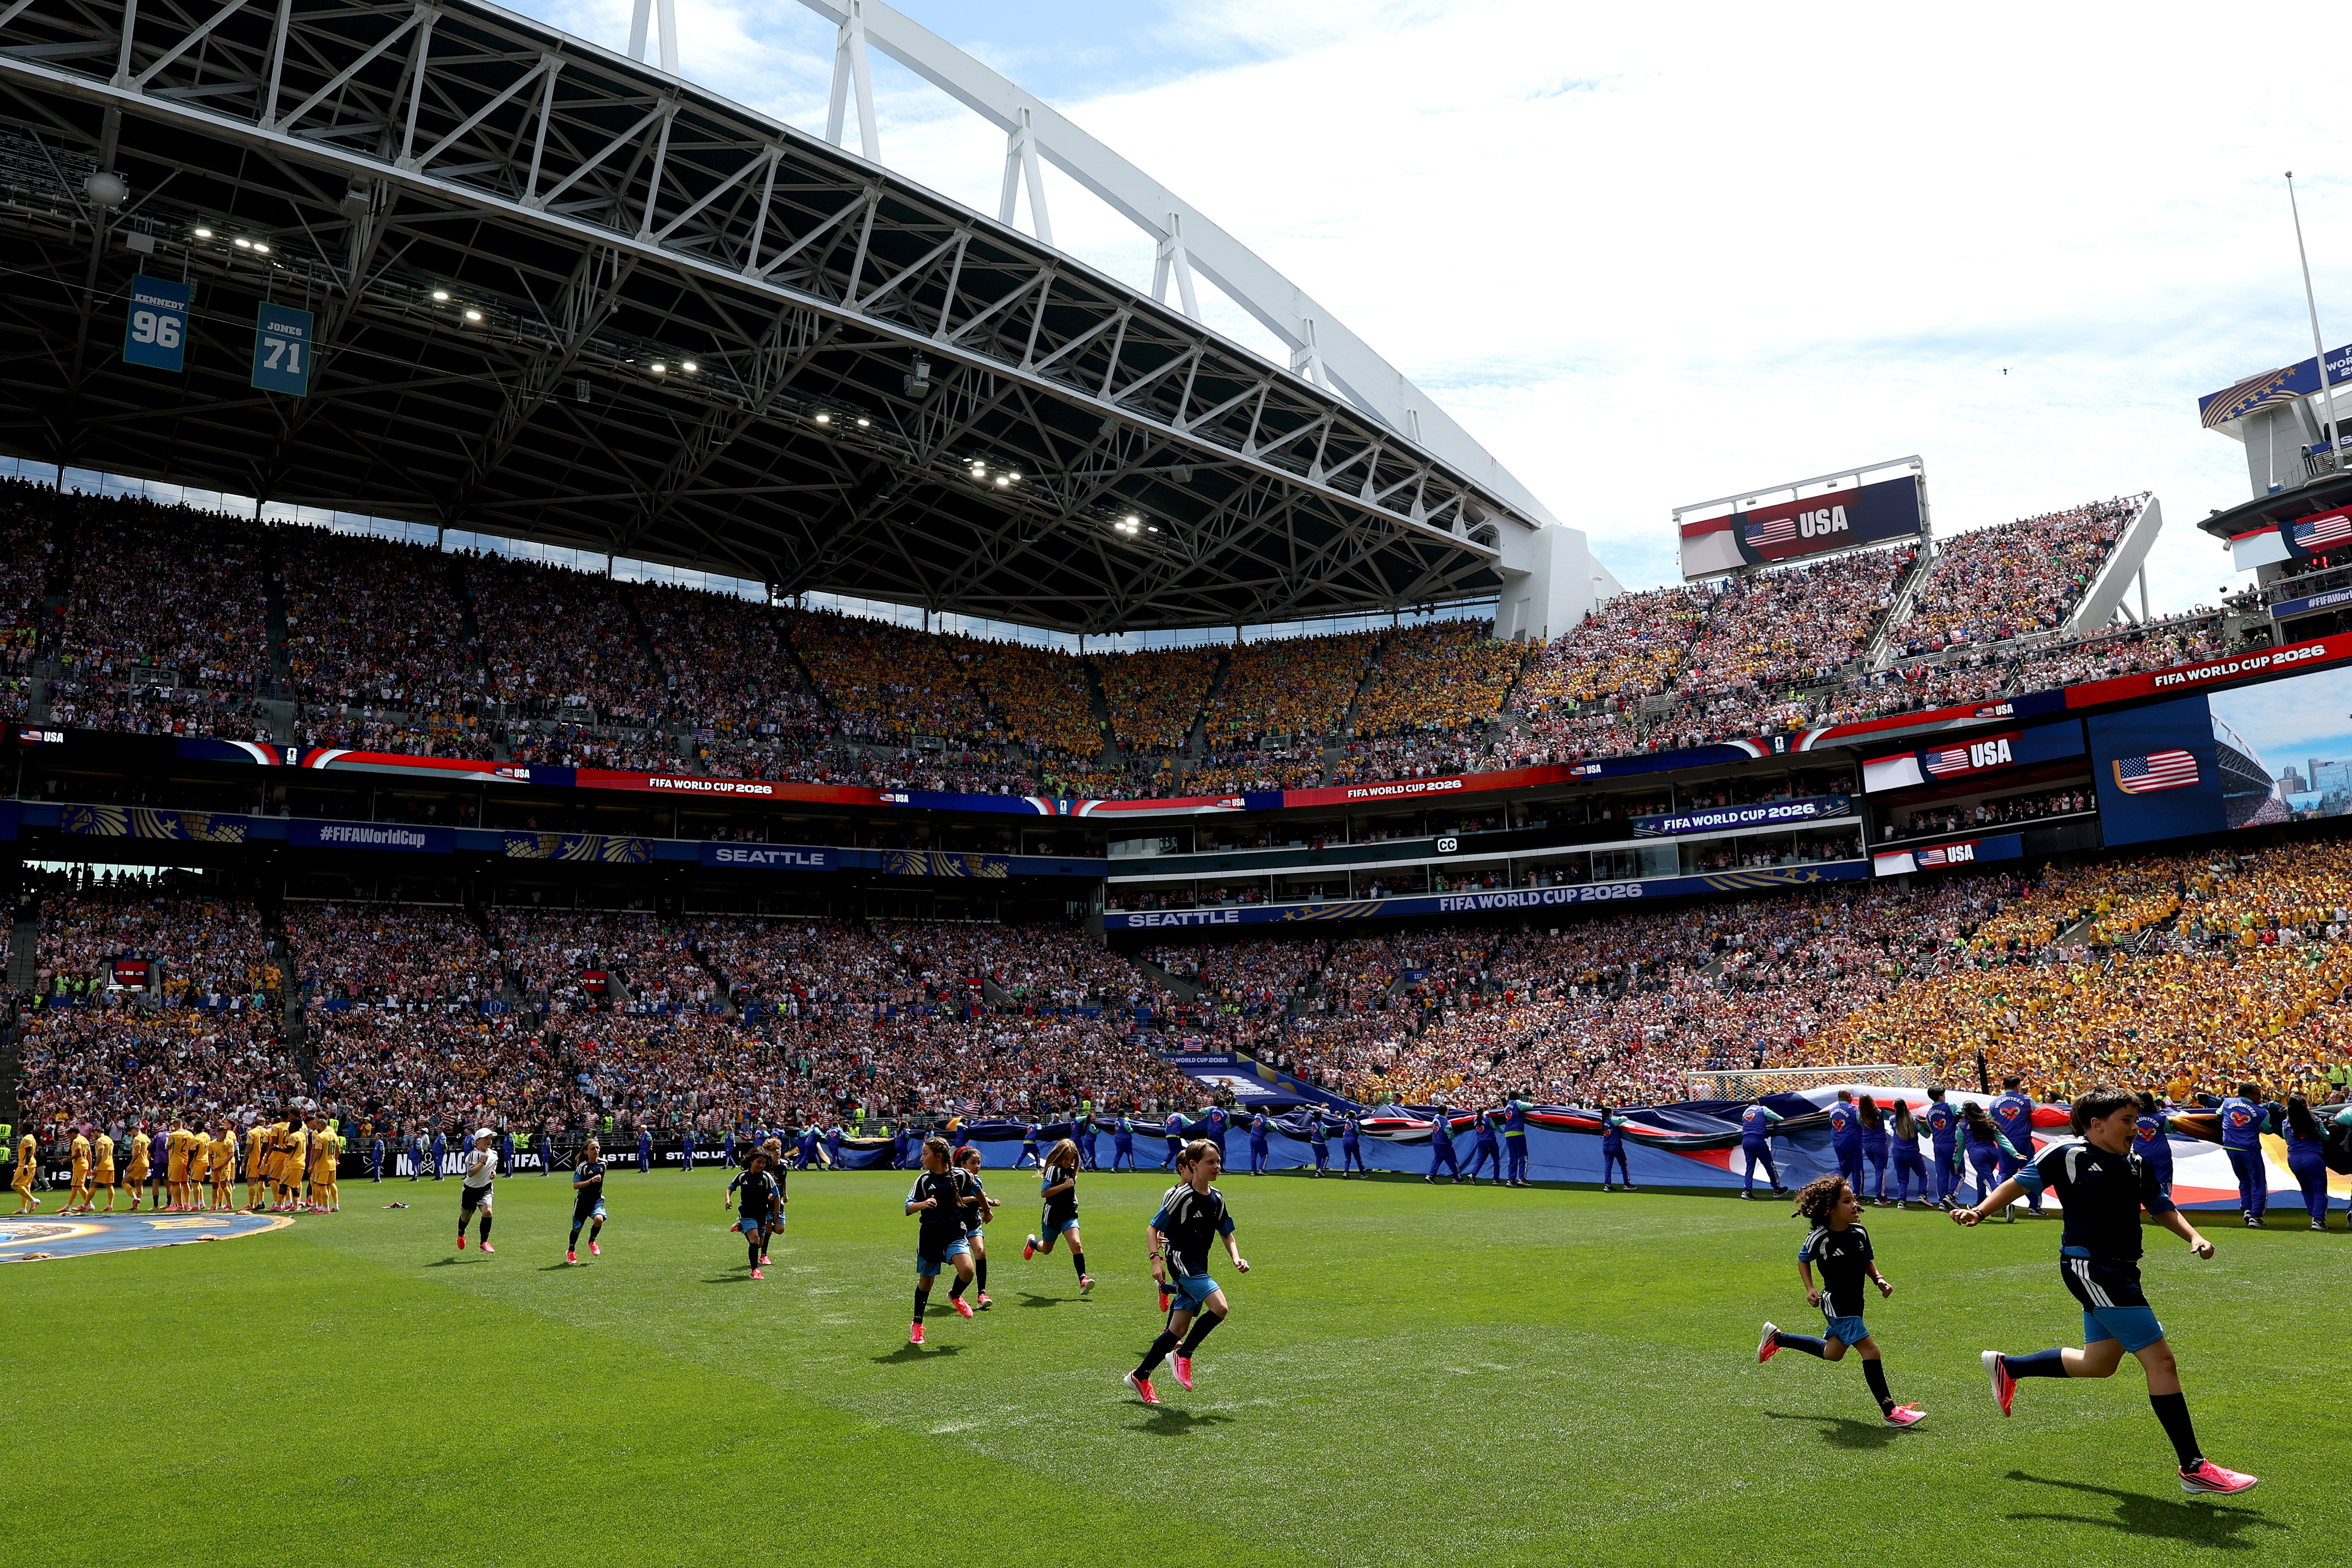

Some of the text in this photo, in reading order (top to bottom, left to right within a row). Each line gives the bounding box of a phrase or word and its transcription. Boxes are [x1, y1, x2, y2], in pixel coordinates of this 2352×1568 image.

[135, 294, 184, 310] KENNEDY
[132, 311, 181, 349] 96
[267, 322, 302, 336] JONES
[264, 337, 300, 374] 71
[2326, 357, 2352, 371] WOR
[1799, 505, 1849, 538] USA
[2308, 590, 2352, 608] #FIFAWorl
[2155, 645, 2325, 687] FIFA WORLD CUP 2026
[141, 669, 171, 679] 310
[565, 709, 589, 718] 312
[1995, 703, 2014, 716] USA
[44, 731, 63, 743] USA
[1970, 738, 2012, 767] USA
[514, 768, 530, 779] USA
[1586, 764, 1602, 774] USA
[649, 778, 772, 794] FIFA WORLD CUP 2026
[1347, 780, 1461, 798] FIFA WORLD CUP 2026
[895, 794, 909, 803] USA
[1232, 798, 1245, 807] USA
[1664, 803, 1816, 830] FIFA WORLD CUP 2026
[320, 826, 425, 848] #FIFAWorldCup
[1439, 840, 1455, 850] CC
[716, 849, 824, 865] SEATTLE
[1947, 844, 1974, 863] USA
[1440, 883, 1643, 911] FIFA WORLD CUP 2026
[1128, 910, 1239, 927] SEATTLE
[1995, 1096, 2024, 1109] VOLUNTEER
[2228, 1102, 2257, 1117] VOLUNTEER
[181, 1138, 187, 1152] 2
[602, 1153, 639, 1162] ISTE
[665, 1151, 709, 1160] STND
